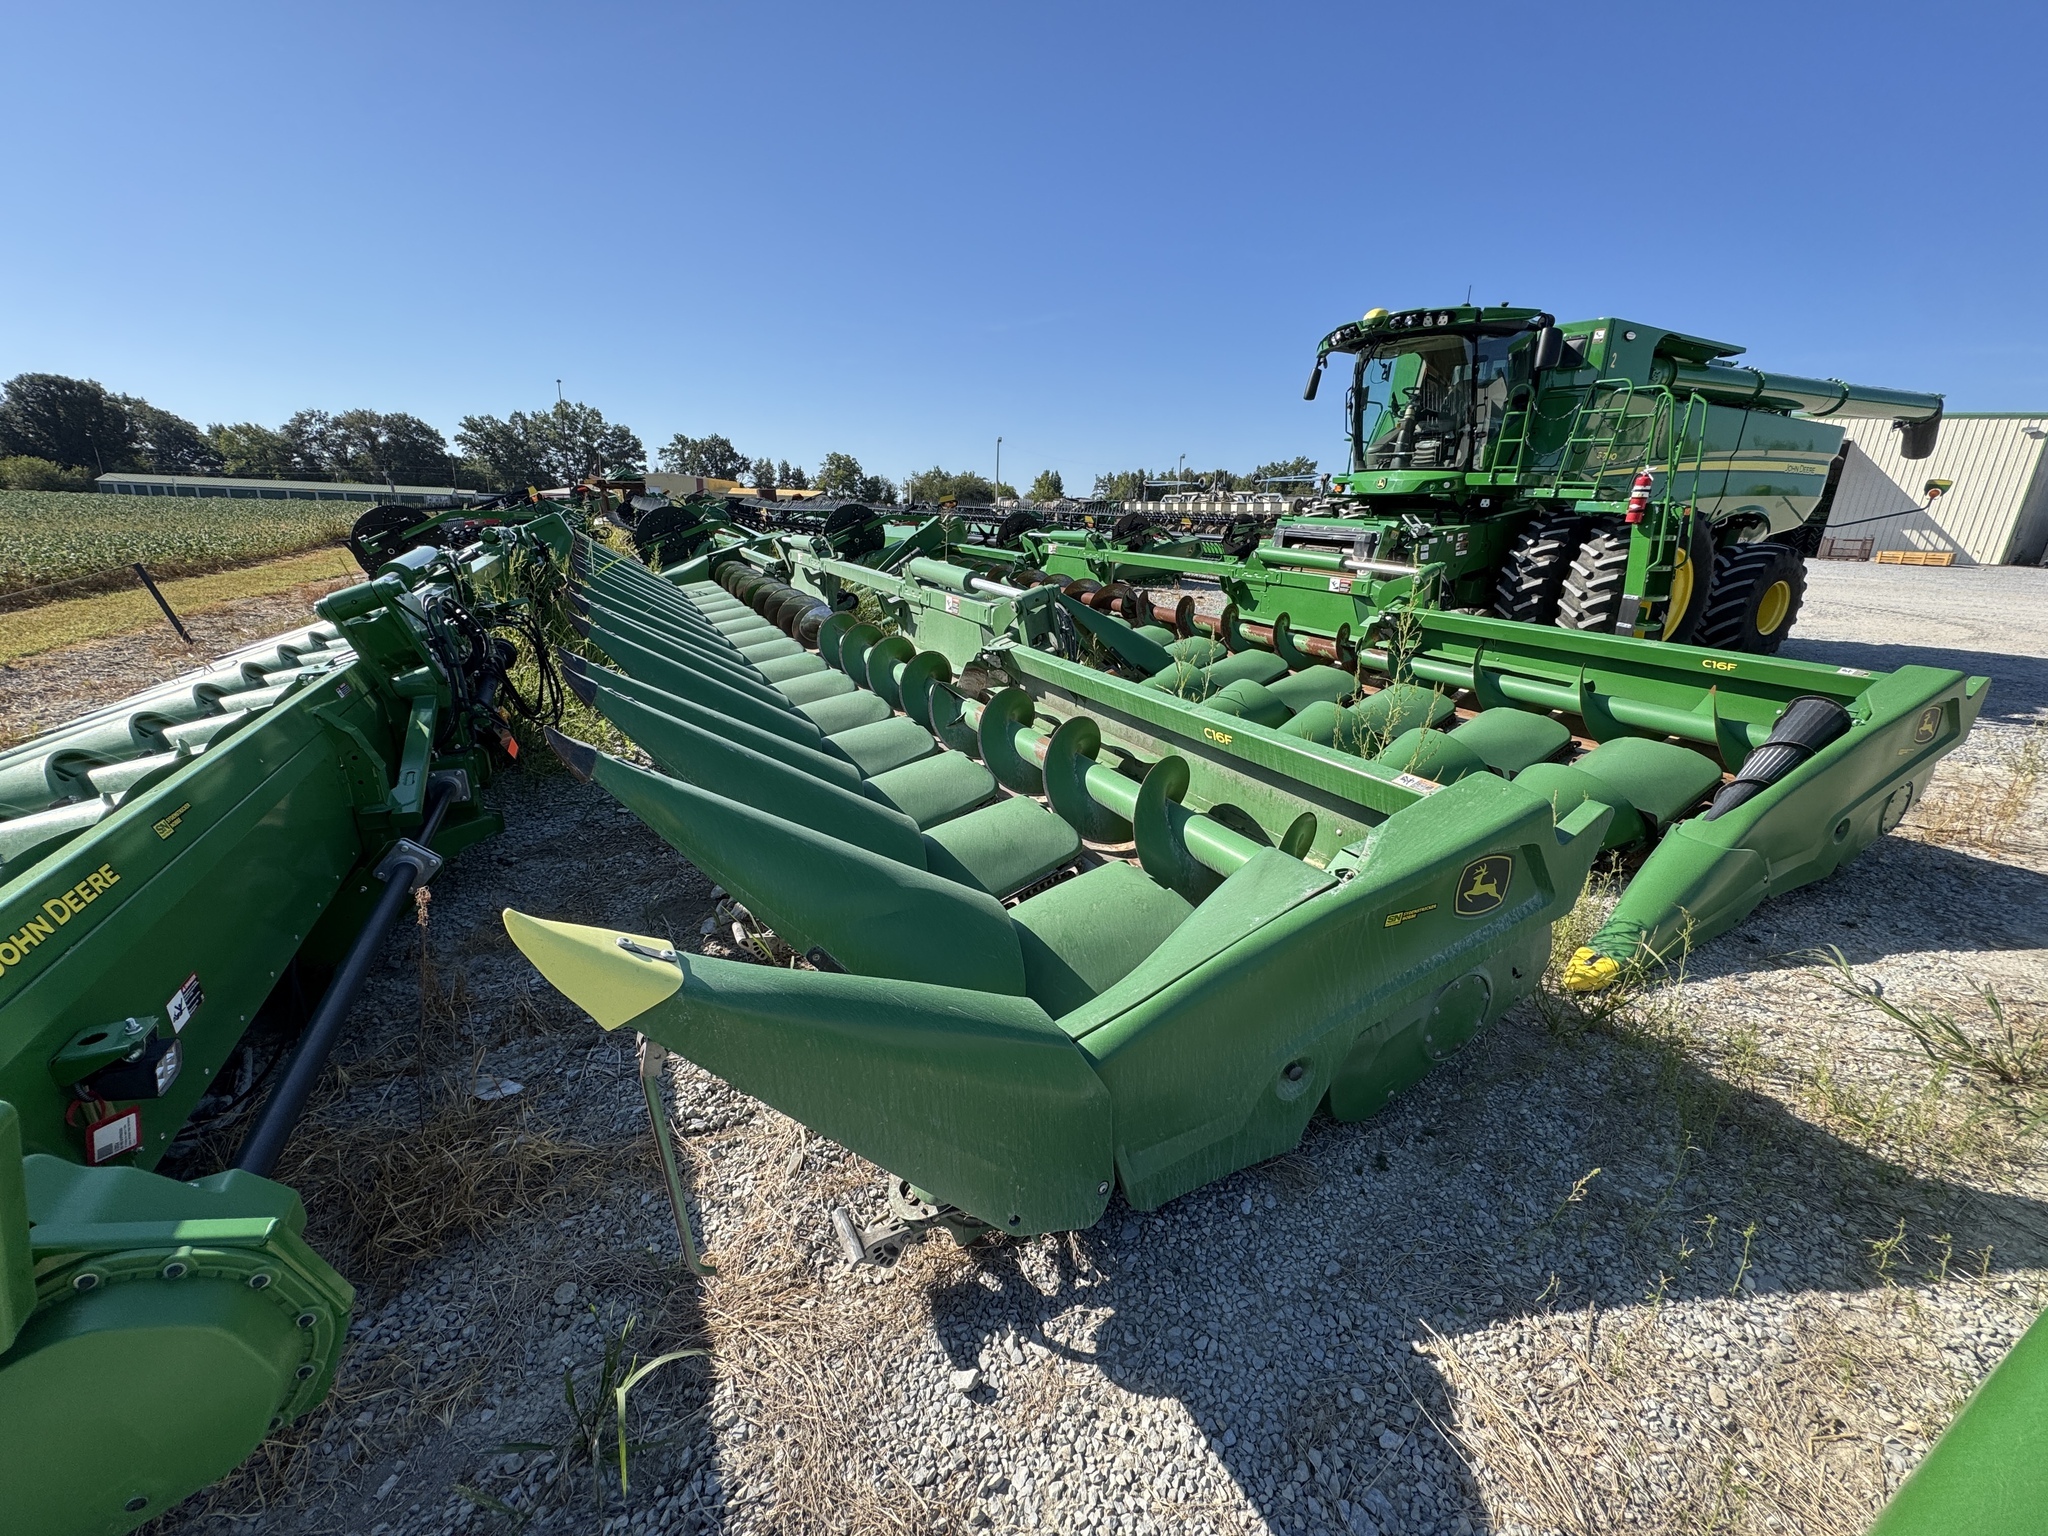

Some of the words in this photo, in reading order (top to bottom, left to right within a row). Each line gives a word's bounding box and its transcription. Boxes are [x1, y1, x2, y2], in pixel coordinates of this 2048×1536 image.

[1702, 660, 1738, 671] C16F
[1204, 728, 1233, 745] C16F
[0, 914, 56, 977] OHN
[42, 863, 121, 927] DEERE
